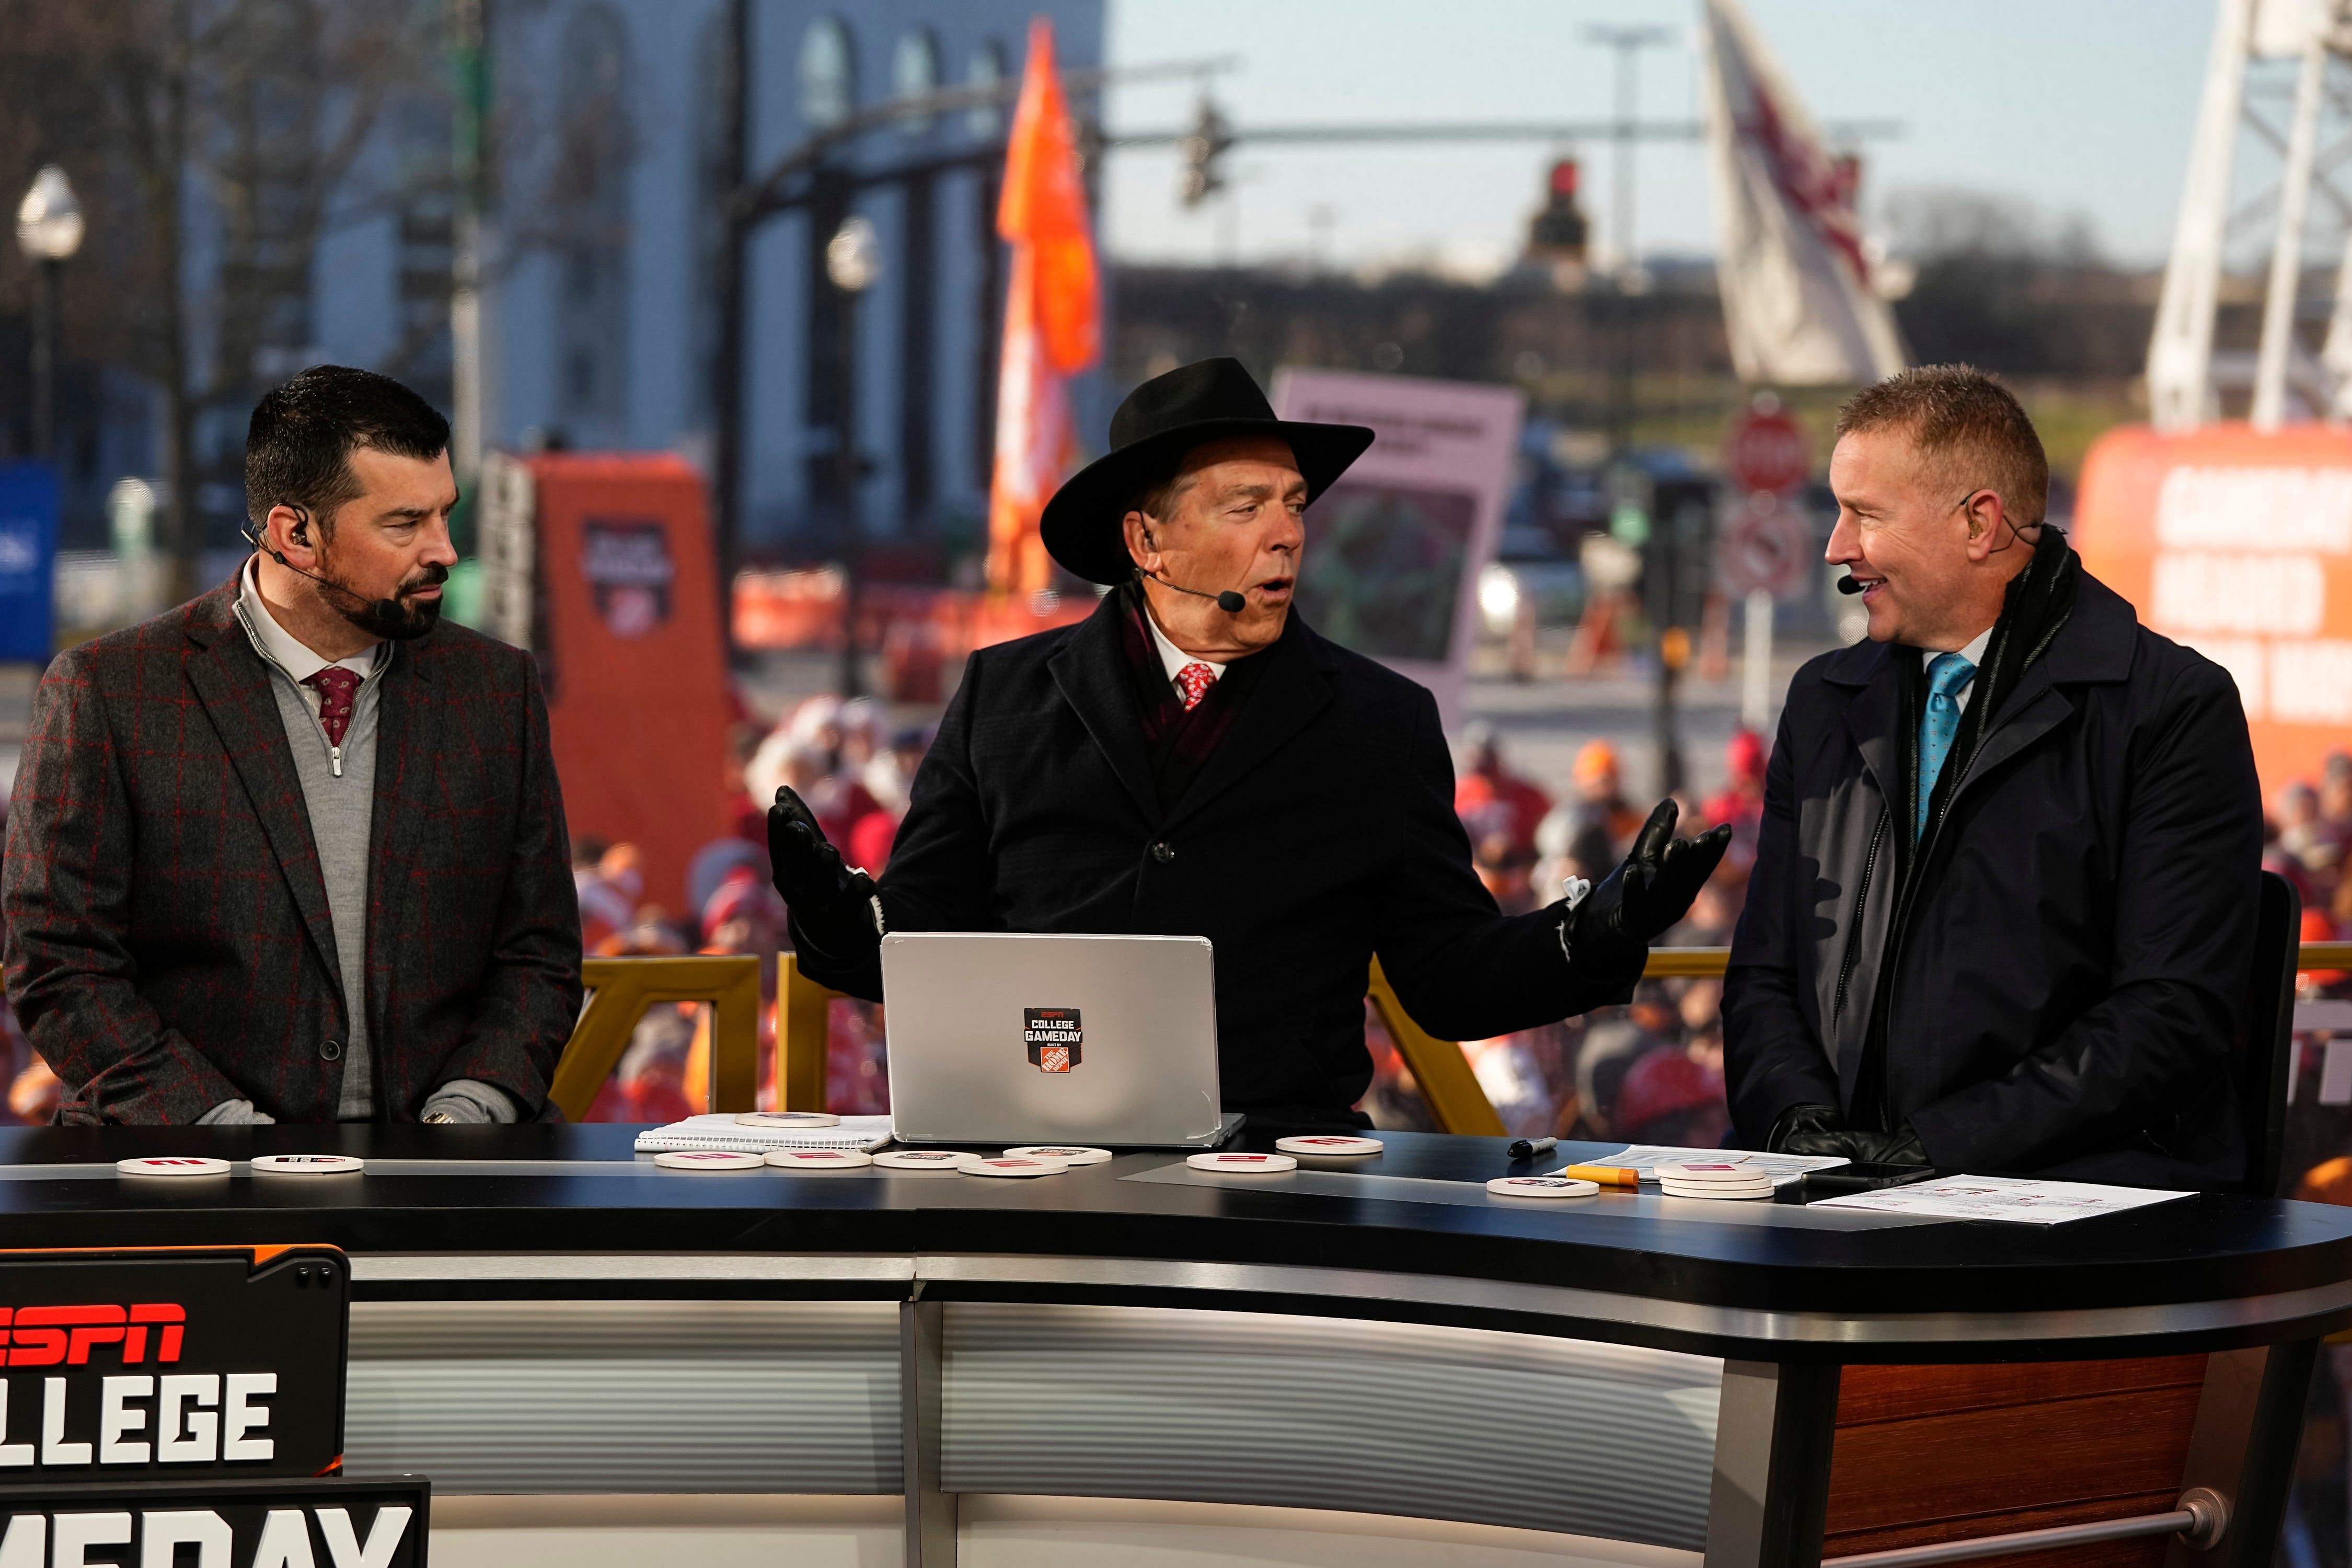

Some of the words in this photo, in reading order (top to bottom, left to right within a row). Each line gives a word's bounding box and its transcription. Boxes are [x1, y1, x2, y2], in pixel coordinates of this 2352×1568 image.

[1032, 1020, 1074, 1029] COLLEGE
[1025, 1031, 1081, 1041] GAMEDAY
[1042, 1047, 1068, 1071] HOME
[1044, 1050, 1055, 1059] THE
[1052, 1056, 1068, 1071] DEPOT
[0, 1304, 186, 1366] SPN
